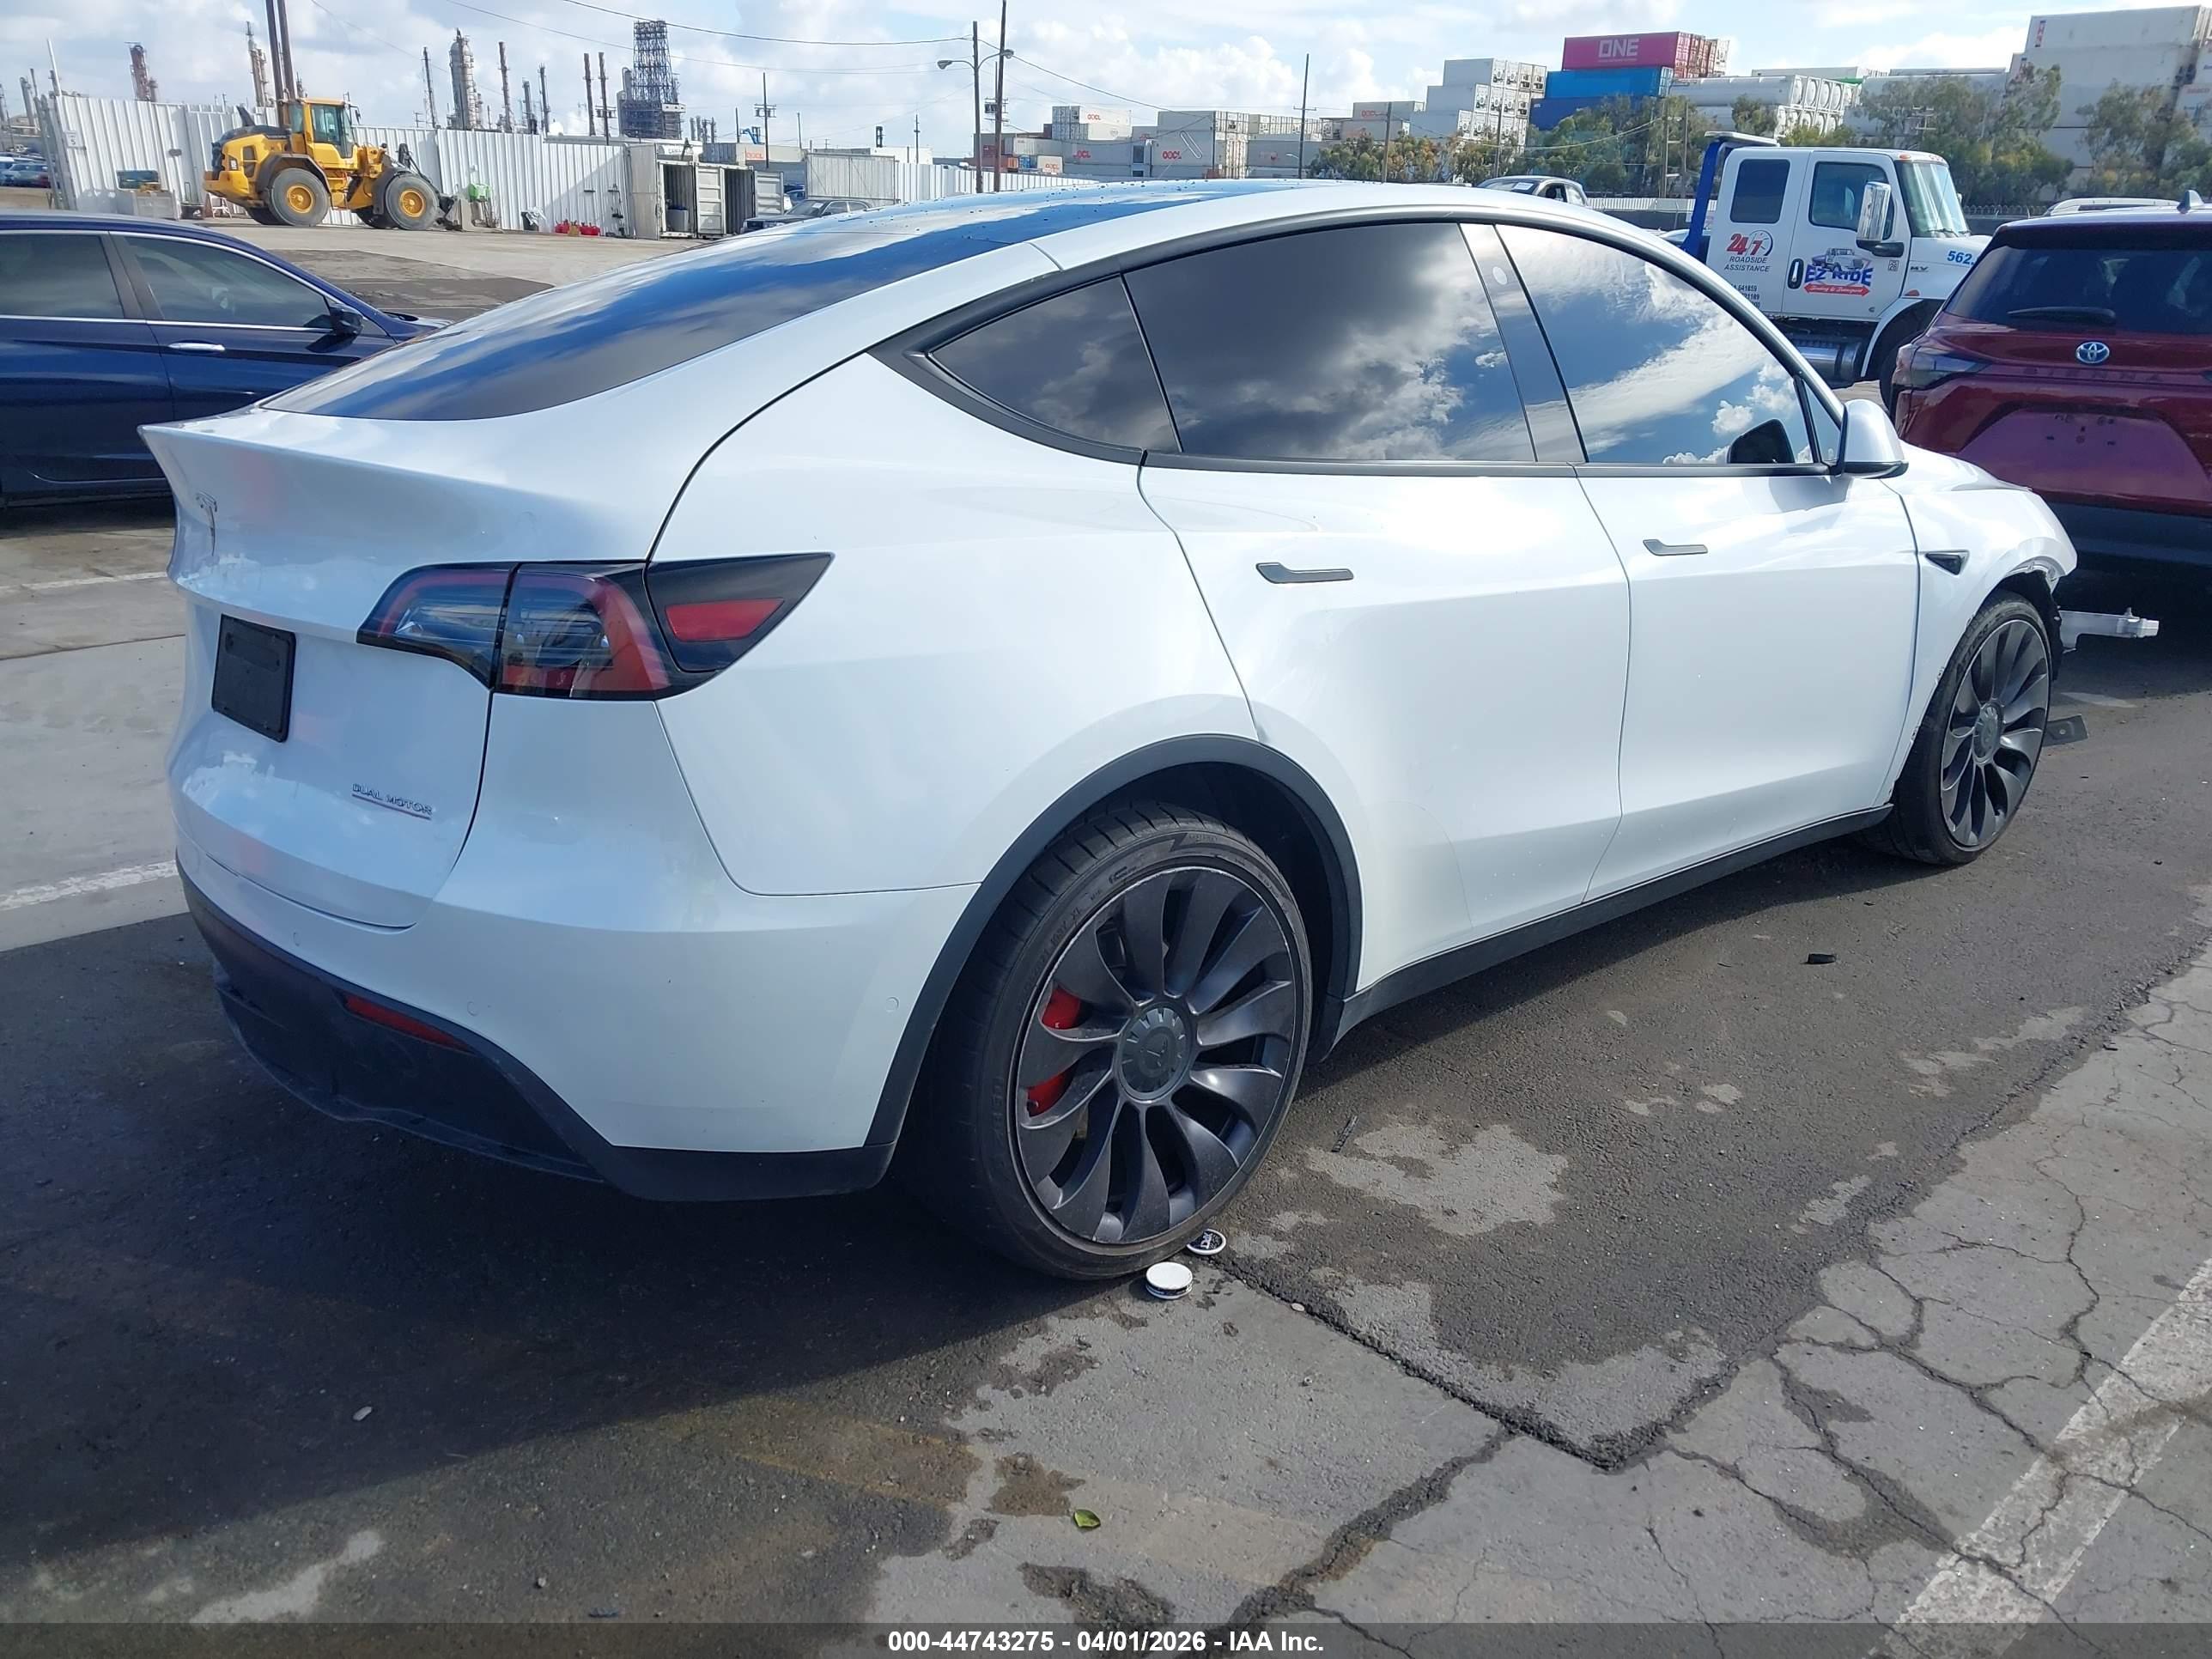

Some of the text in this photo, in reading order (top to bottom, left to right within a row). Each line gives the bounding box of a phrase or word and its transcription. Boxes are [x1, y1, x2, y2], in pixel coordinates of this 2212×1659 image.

[1598, 38, 1640, 58] ONE
[1804, 264, 1827, 283] EZ
[1832, 268, 1875, 288] RIDE
[352, 783, 383, 800] DUAL
[386, 794, 433, 815] MOTOR
